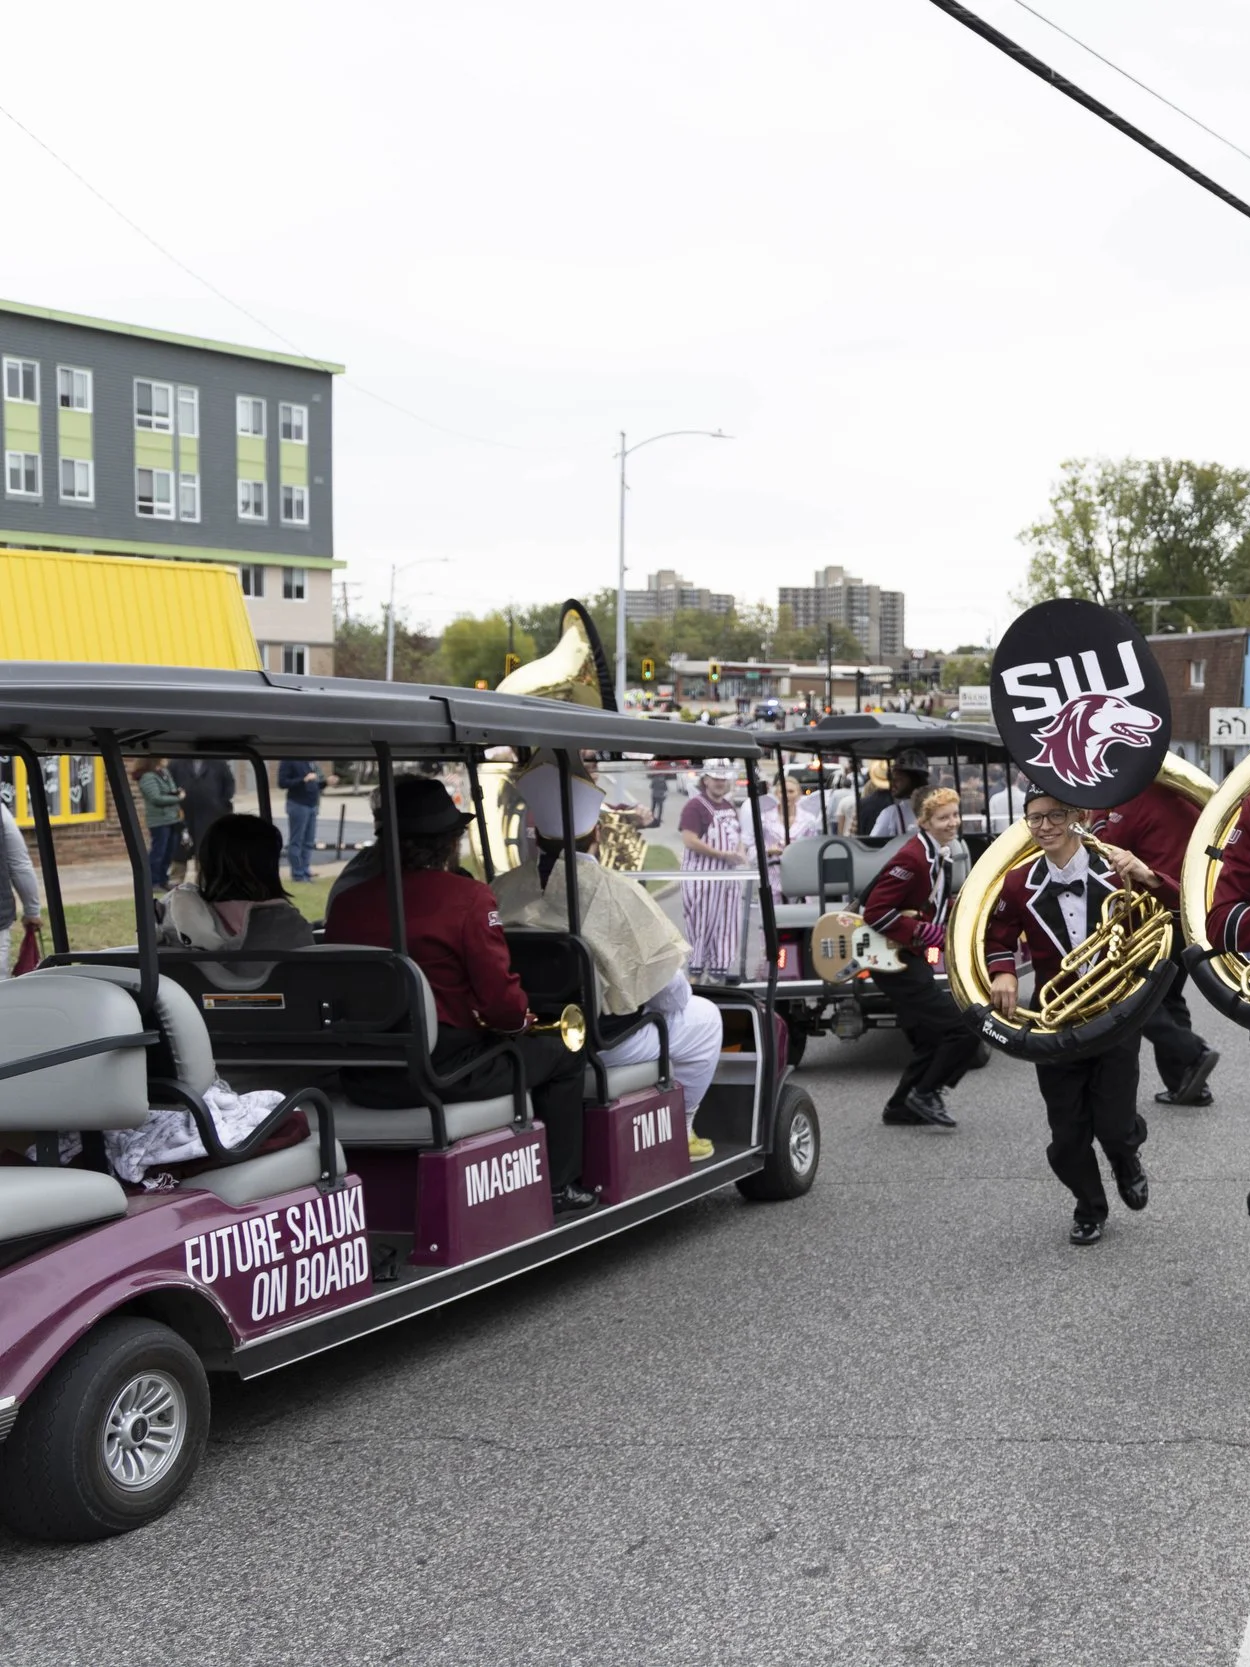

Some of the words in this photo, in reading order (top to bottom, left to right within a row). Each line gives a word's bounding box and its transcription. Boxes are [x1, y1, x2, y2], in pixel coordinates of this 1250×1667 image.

[1000, 640, 1145, 722] SIU
[982, 1025, 1009, 1045] KING
[657, 1106, 673, 1143] IN
[184, 1211, 285, 1285] FUTURE
[286, 1185, 366, 1255] SALUKI
[251, 1264, 288, 1322] ON
[294, 1236, 369, 1307] BOARD
